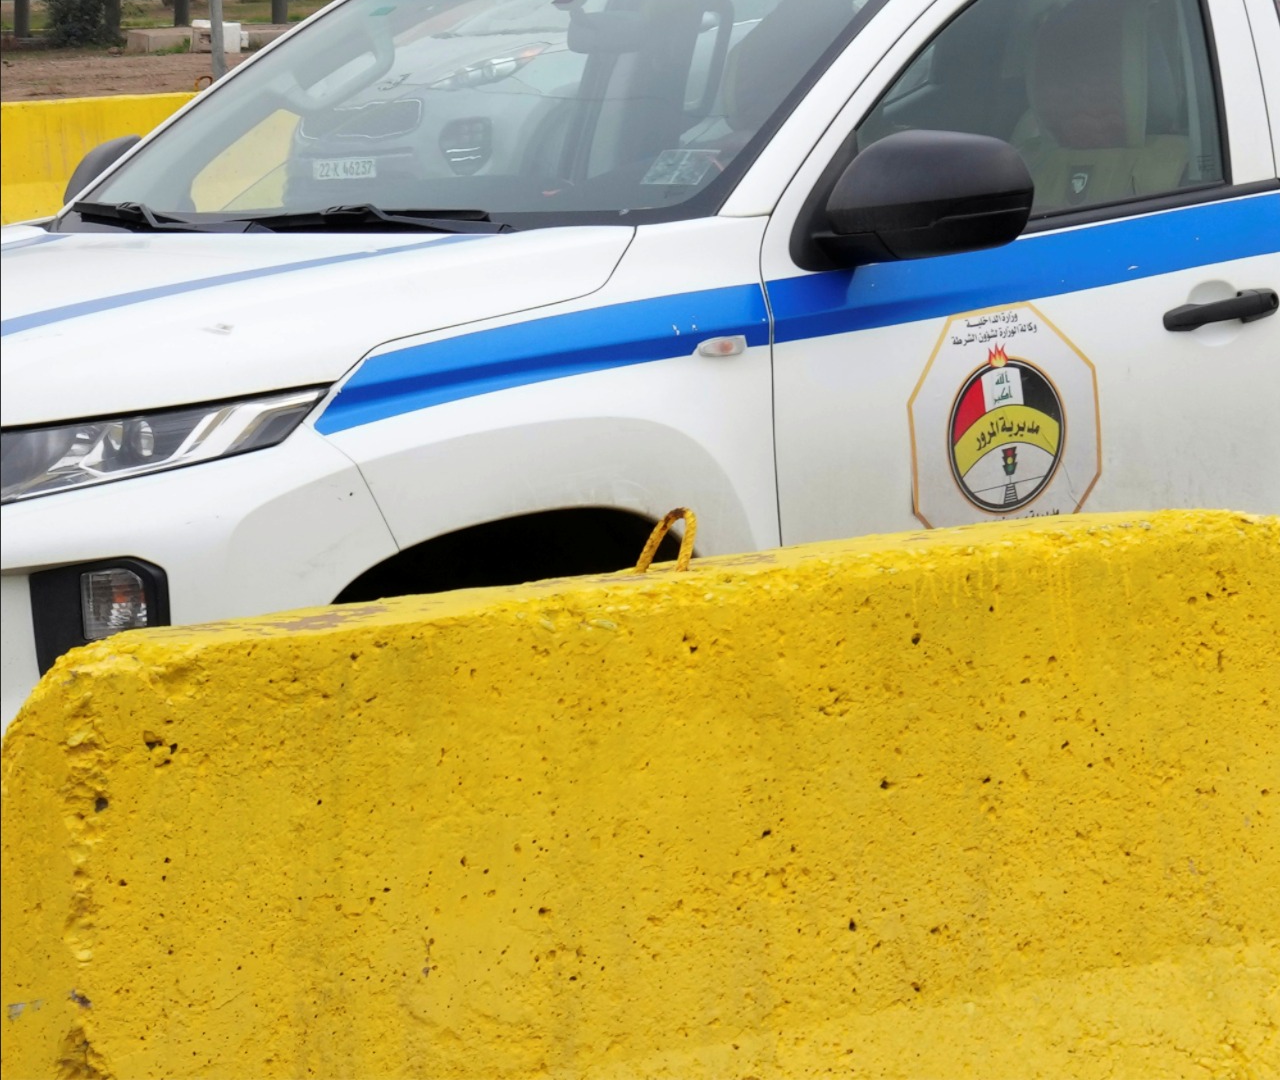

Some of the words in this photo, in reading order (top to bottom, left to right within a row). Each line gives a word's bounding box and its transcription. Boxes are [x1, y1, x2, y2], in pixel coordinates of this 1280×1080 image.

[319, 162, 331, 177] 22
[976, 421, 999, 451] المرور
[999, 417, 1040, 437] مديرية
